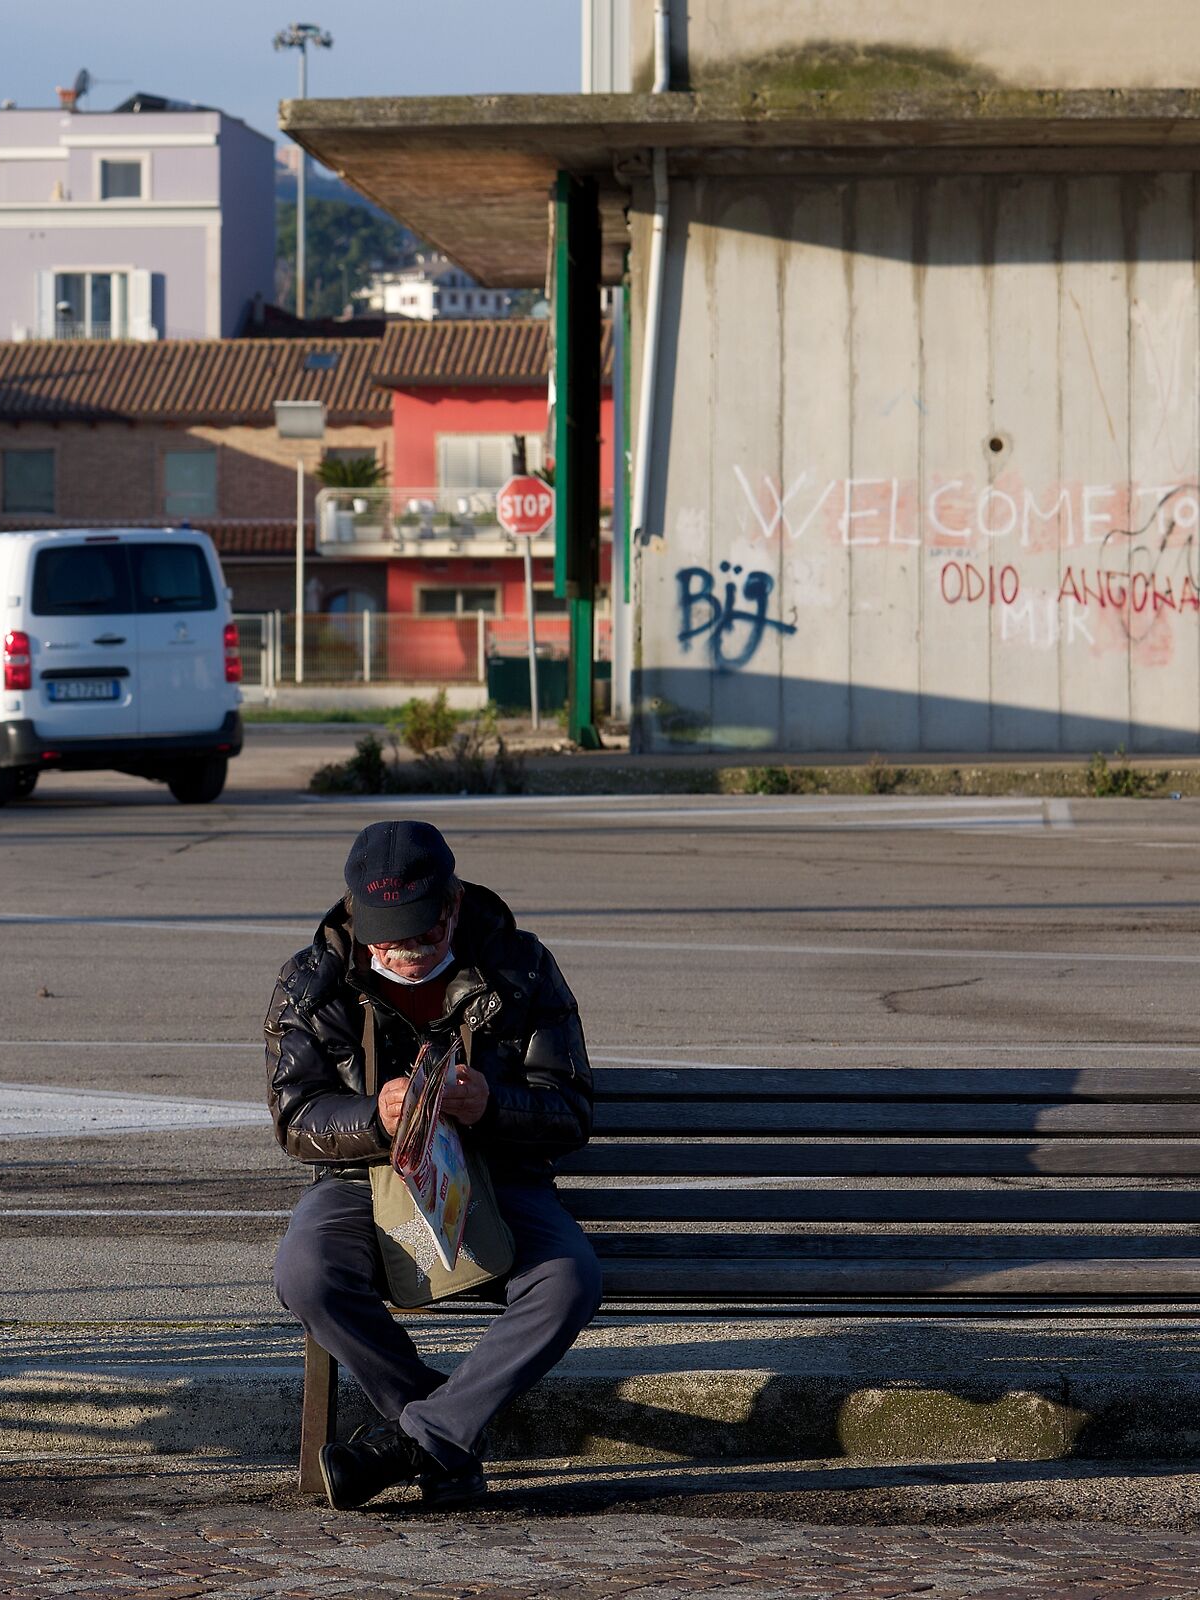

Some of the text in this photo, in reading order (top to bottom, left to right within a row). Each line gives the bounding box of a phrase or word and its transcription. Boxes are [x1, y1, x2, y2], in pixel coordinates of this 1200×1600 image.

[501, 493, 551, 519] STOP
[733, 464, 1116, 549] WELCOME
[940, 561, 1020, 605] ODIO
